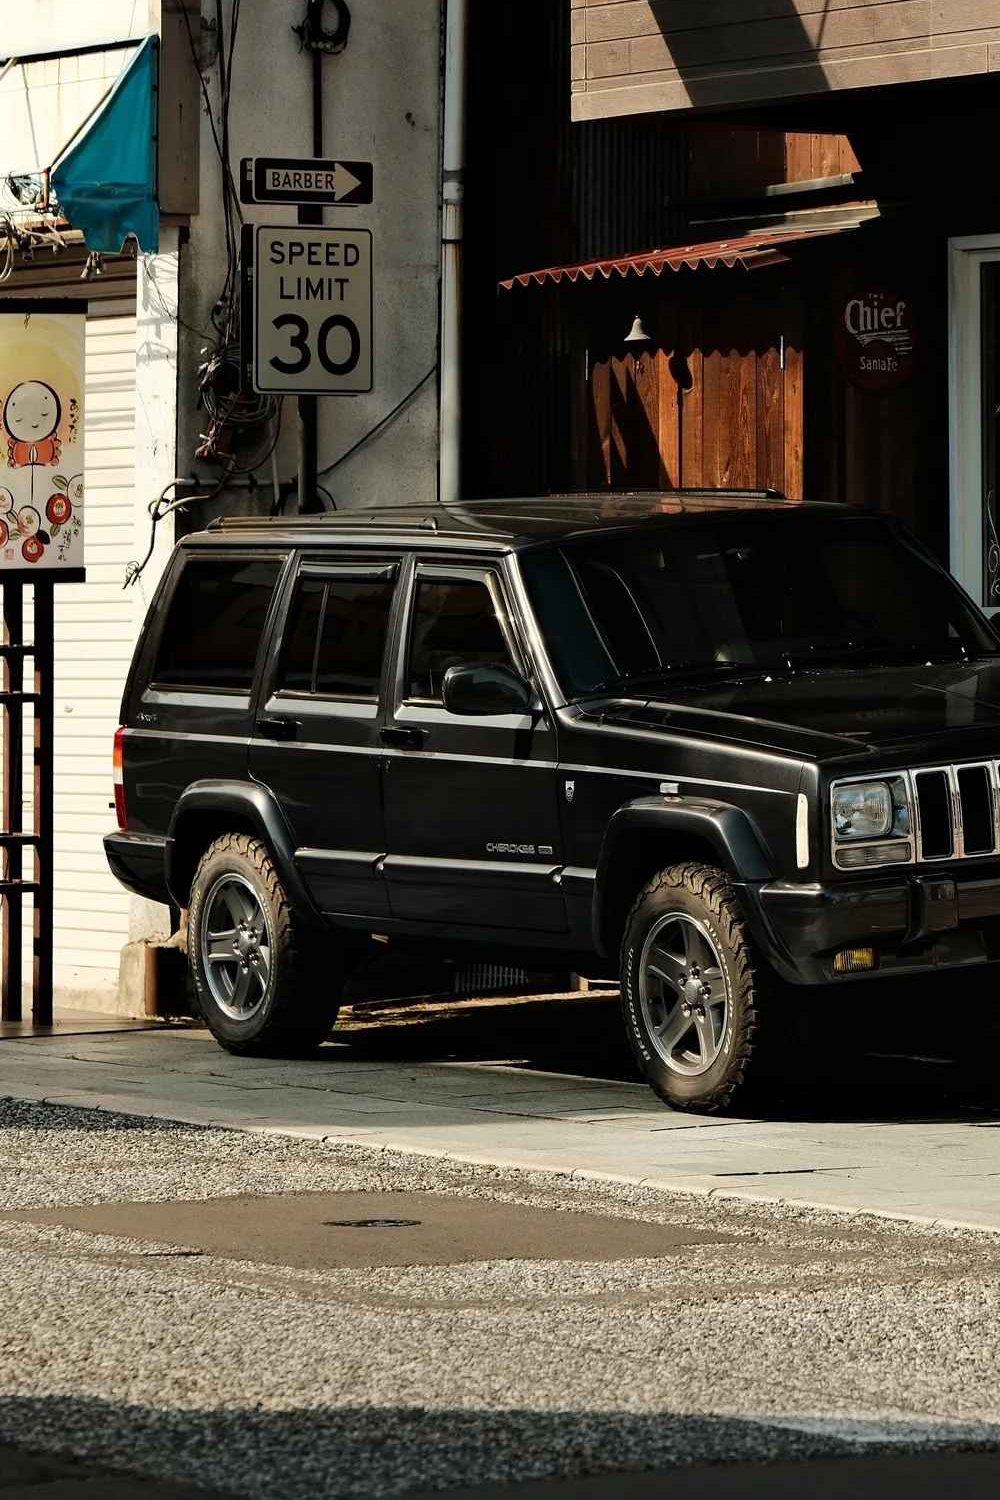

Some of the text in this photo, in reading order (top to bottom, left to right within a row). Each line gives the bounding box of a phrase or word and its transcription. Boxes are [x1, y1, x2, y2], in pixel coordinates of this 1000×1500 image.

[271, 171, 335, 190] BARBER
[269, 240, 361, 267] SPEED
[279, 276, 350, 301] LIMIT
[844, 299, 906, 334] Chief
[268, 313, 361, 376] 30
[486, 842, 536, 855] CHEROKEE
[627, 948, 651, 1061] BFGoodrich
